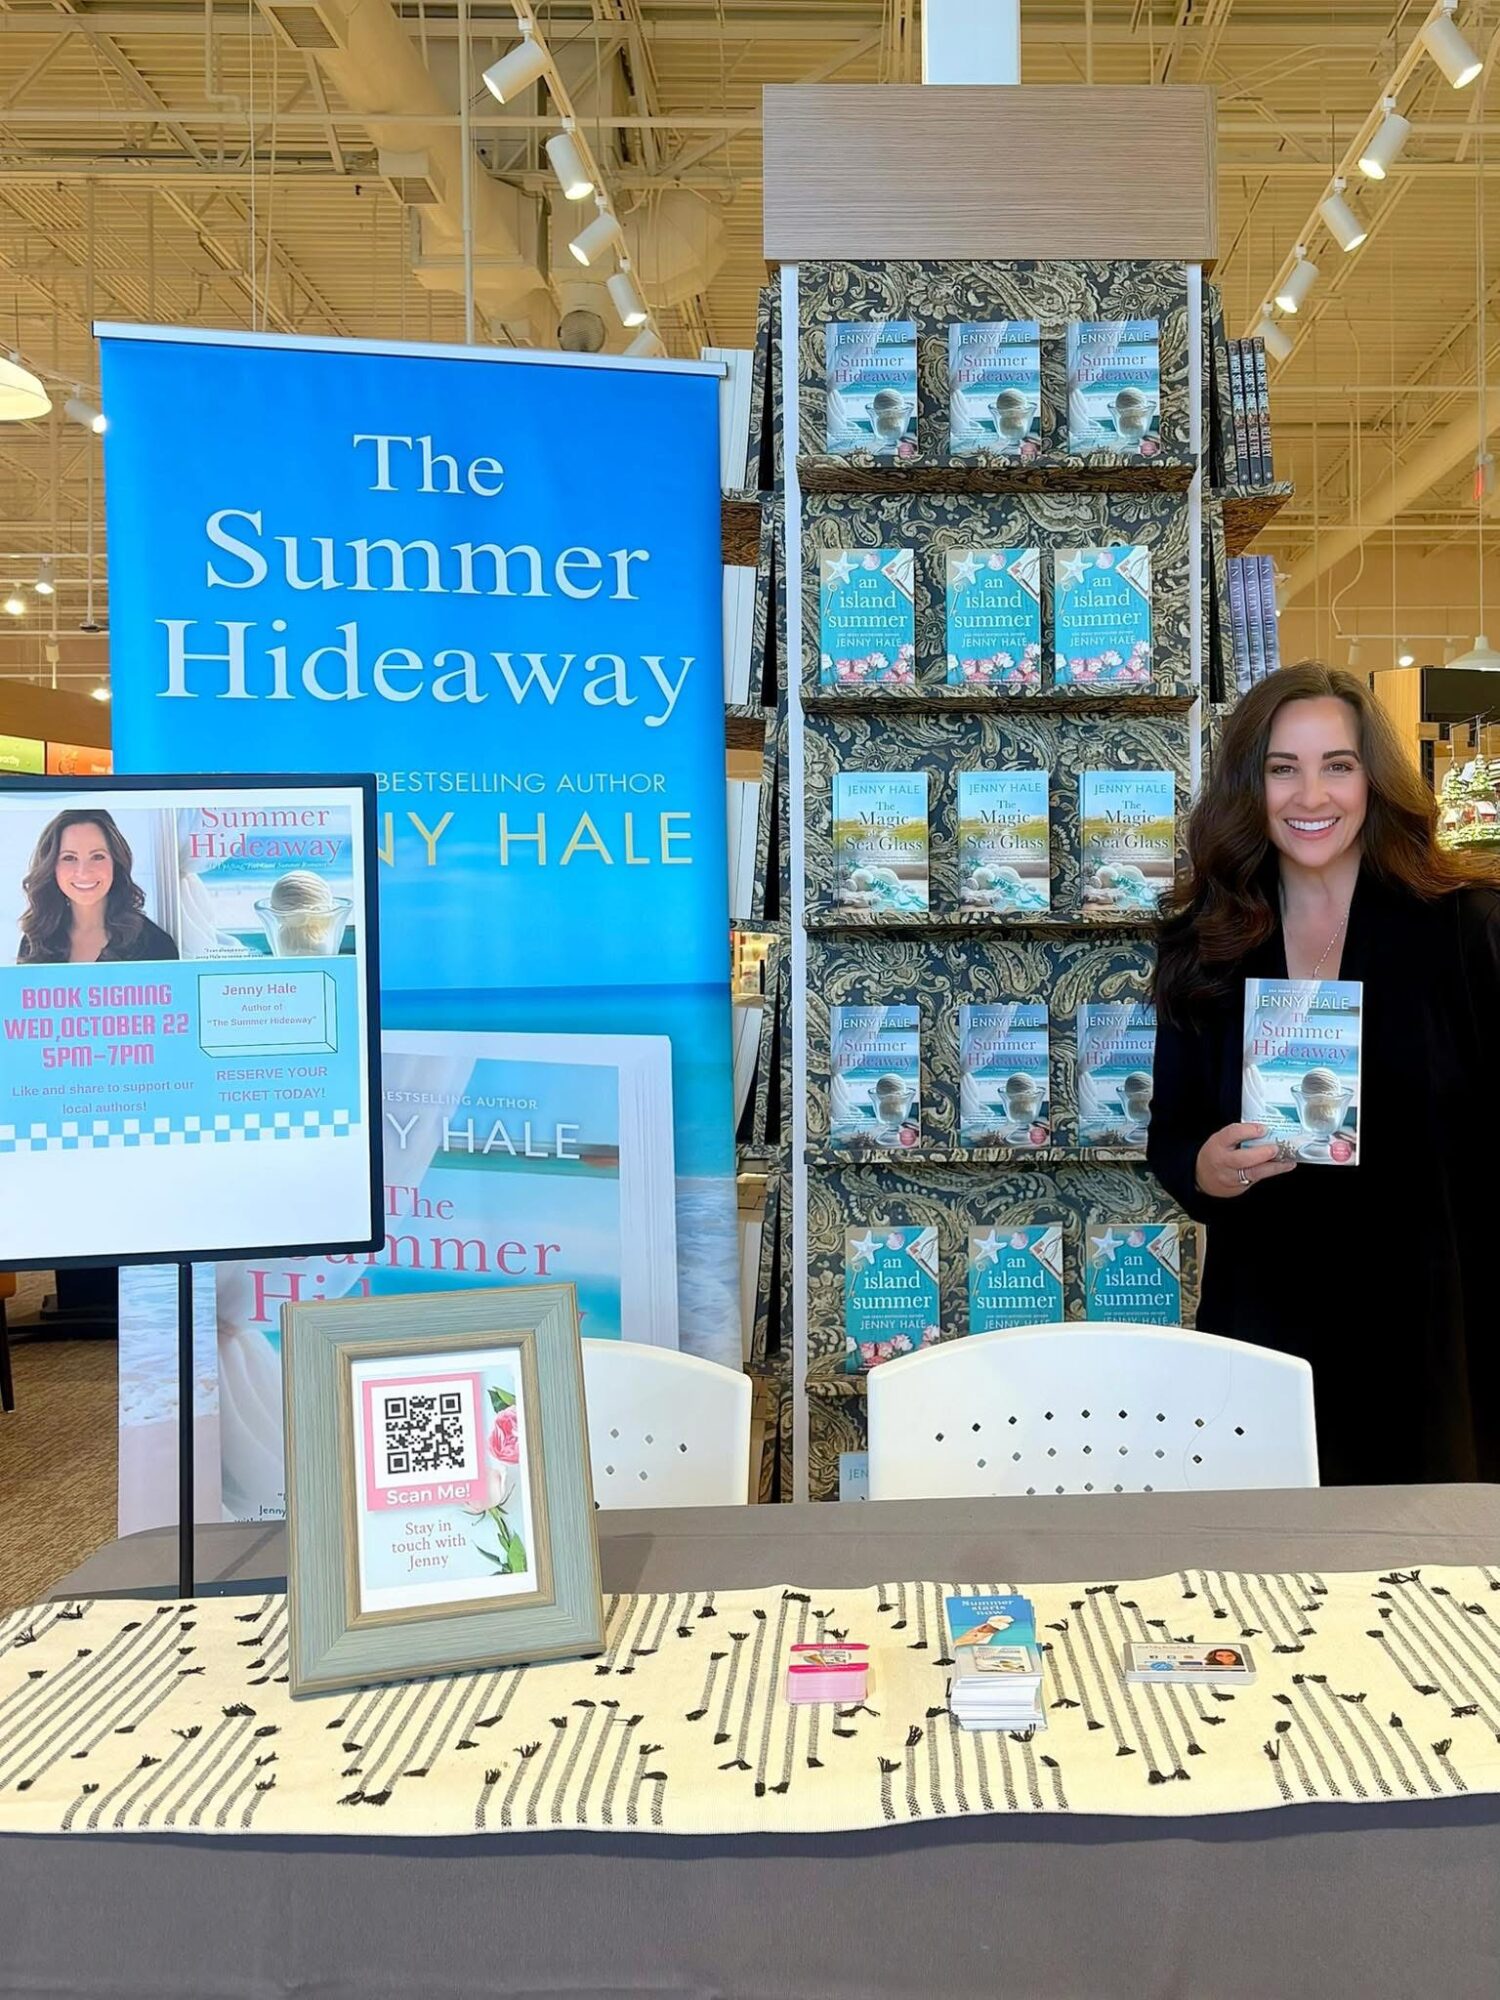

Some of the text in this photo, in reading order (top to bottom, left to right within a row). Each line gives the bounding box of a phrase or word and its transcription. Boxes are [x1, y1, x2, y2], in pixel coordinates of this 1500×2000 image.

[834, 332, 907, 346] JENNY HALE
[957, 332, 1030, 345] JENNY HALE
[1077, 332, 1149, 345] JENNY HALE
[841, 353, 904, 367] Summer
[963, 353, 1027, 367] Summer
[1082, 353, 1146, 367] Summer
[835, 369, 910, 385] Hideaway
[957, 369, 1033, 385] Hideaway
[1077, 369, 1152, 384] Hideaway
[354, 433, 505, 497] The
[205, 509, 650, 601] Summer
[859, 577, 877, 589] an
[984, 577, 1003, 589] an
[1092, 576, 1111, 588] an
[839, 591, 896, 608] island
[965, 591, 1022, 608] island
[1073, 589, 1130, 606] island
[828, 614, 907, 628] summer
[954, 614, 1033, 628] summer
[1062, 612, 1141, 627] summer
[835, 637, 901, 648] JENNY HALE
[961, 637, 1027, 648] JENNY HALE
[1069, 636, 1136, 647] JENNY HALE
[155, 619, 695, 728] Hideaway
[377, 772, 666, 794] BESTSELLING AUTHOR
[847, 784, 920, 796] JENNY HALE
[969, 783, 1041, 796] JENNY HALE
[1094, 784, 1167, 796] JENNY HALE
[876, 801, 895, 811] The
[998, 800, 1016, 809] The
[1122, 800, 1141, 810] The
[202, 807, 330, 828] Summer
[858, 812, 909, 829] Magic
[979, 811, 1030, 828] Magic
[1104, 812, 1155, 828] Magic
[500, 811, 692, 866] HALE
[846, 835, 922, 850] Sea Glass
[967, 834, 1043, 849] Sea Glass
[1090, 834, 1167, 850] Sea Glass
[189, 833, 343, 863] Hideaway
[22, 985, 172, 1009] BOOK SIGNING
[222, 983, 297, 997] Jenny Hale
[242, 1004, 271, 1012] Author
[1255, 995, 1349, 1009] JENNY HALE
[163, 1013, 189, 1034] 22
[231, 1018, 267, 1026] Summer
[839, 1017, 911, 1030] JENNY HALE
[968, 1016, 1039, 1029] JENNY HALE
[1085, 1016, 1157, 1029] JENNY HALE
[1262, 1021, 1343, 1039] Summer
[843, 1038, 906, 1053] Summer
[973, 1037, 1036, 1052] Summer
[1091, 1037, 1155, 1051] Summer
[1253, 1039, 1349, 1064] Hideaway
[43, 1043, 154, 1068] 5PM-7PM
[837, 1054, 912, 1070] Hideaway
[968, 1053, 1041, 1069] Hideaway
[1086, 1052, 1154, 1067] Hideawa
[216, 1066, 328, 1080] RESERVE YOUR
[12, 1081, 194, 1097] Like and share to support our
[219, 1088, 326, 1102] TICKET TODAY!
[62, 1101, 147, 1114] local authors!
[477, 1096, 537, 1110] AUTHOR
[442, 1116, 580, 1160] HALE
[385, 1185, 454, 1220] The
[289, 1232, 561, 1276] mmer
[1007, 1255, 1026, 1268] an
[1124, 1255, 1143, 1267] an
[883, 1256, 902, 1269] an
[864, 1270, 920, 1289] island
[987, 1270, 1045, 1289] island
[1105, 1268, 1162, 1287] island
[853, 1295, 932, 1309] summer
[977, 1294, 1056, 1309] summer
[1095, 1291, 1173, 1307] summer
[860, 1319, 926, 1330] JENNY HALE
[387, 1483, 471, 1505] Scan Me!
[405, 1520, 452, 1537] Stay in
[392, 1534, 466, 1554] touch with
[407, 1555, 449, 1572] Jenny
